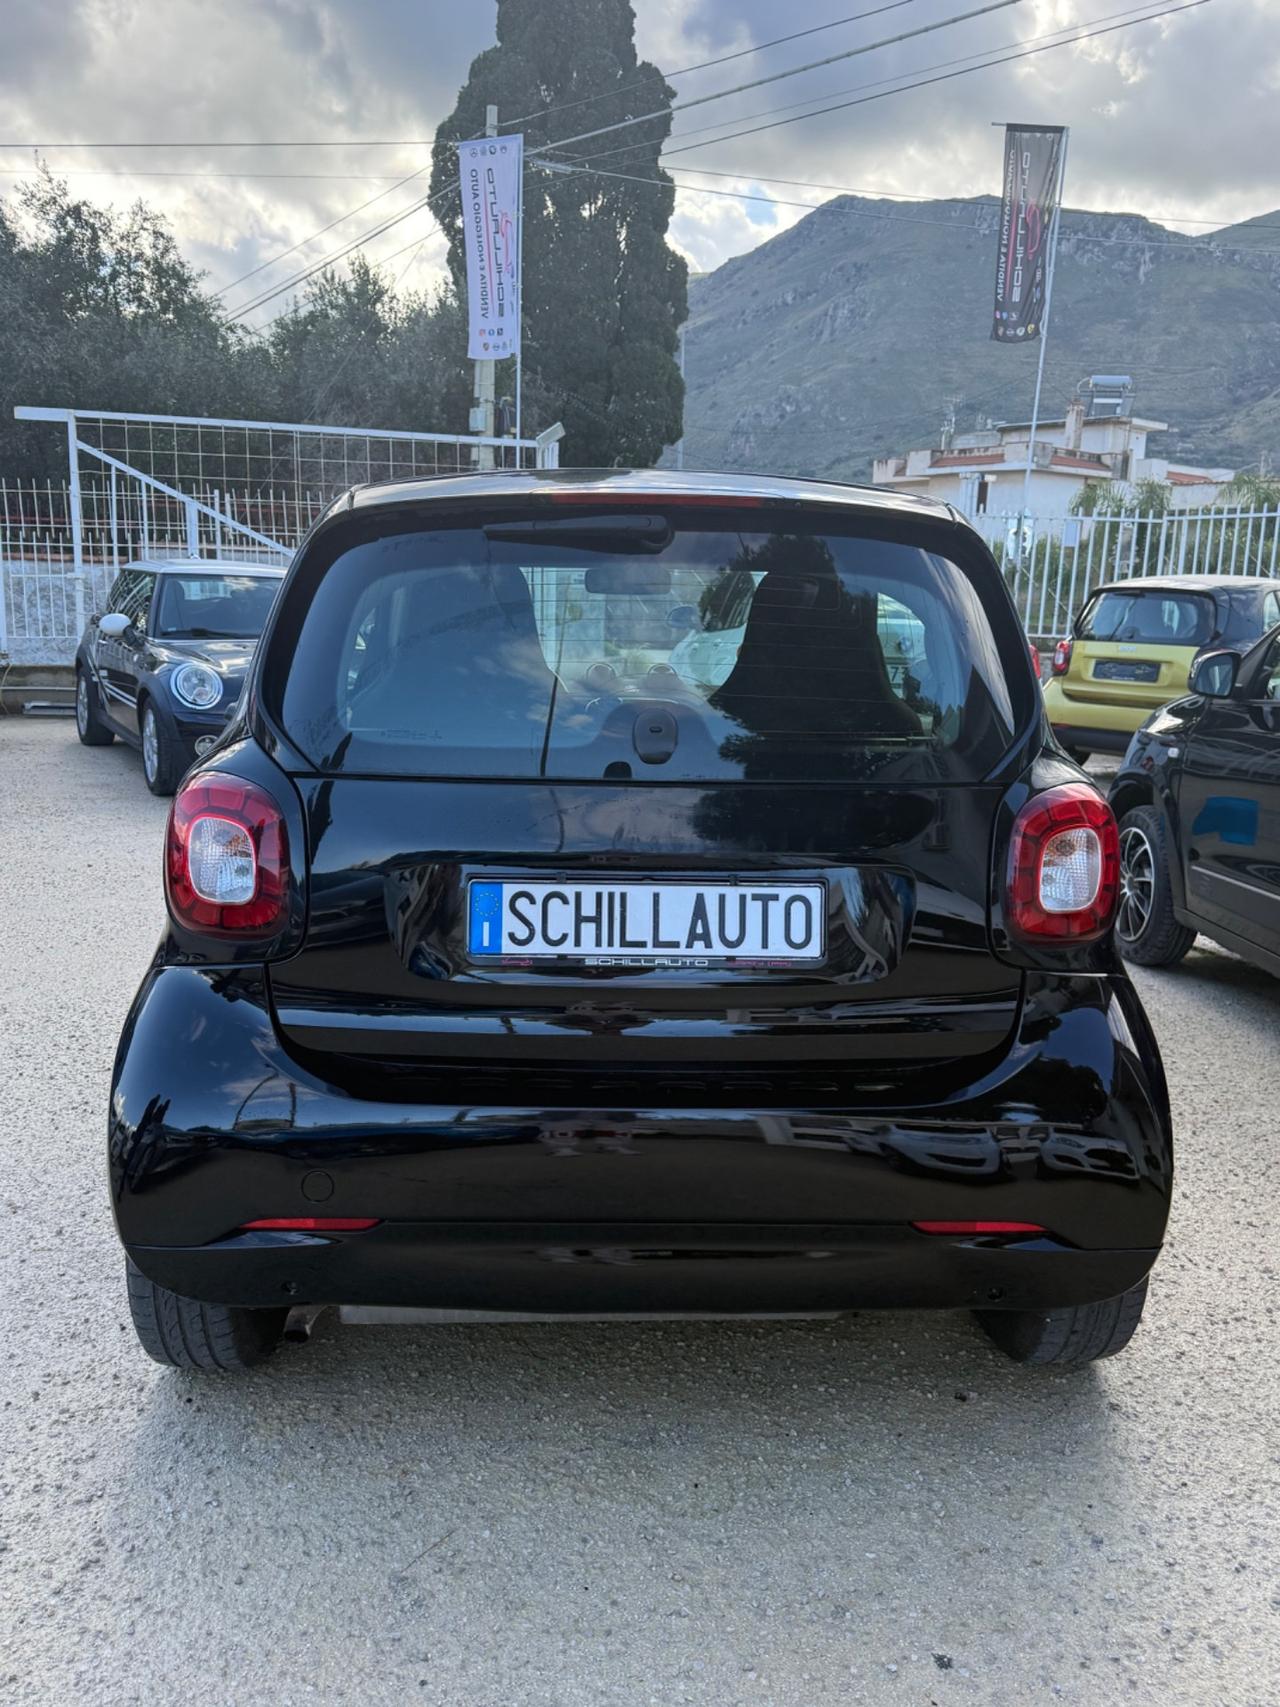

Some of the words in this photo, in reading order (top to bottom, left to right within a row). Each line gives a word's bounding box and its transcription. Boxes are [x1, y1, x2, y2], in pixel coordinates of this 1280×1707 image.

[483, 922, 490, 947] I
[508, 890, 812, 950] SCHILLAUTO
[585, 958, 709, 967] SCHILLAUTO
